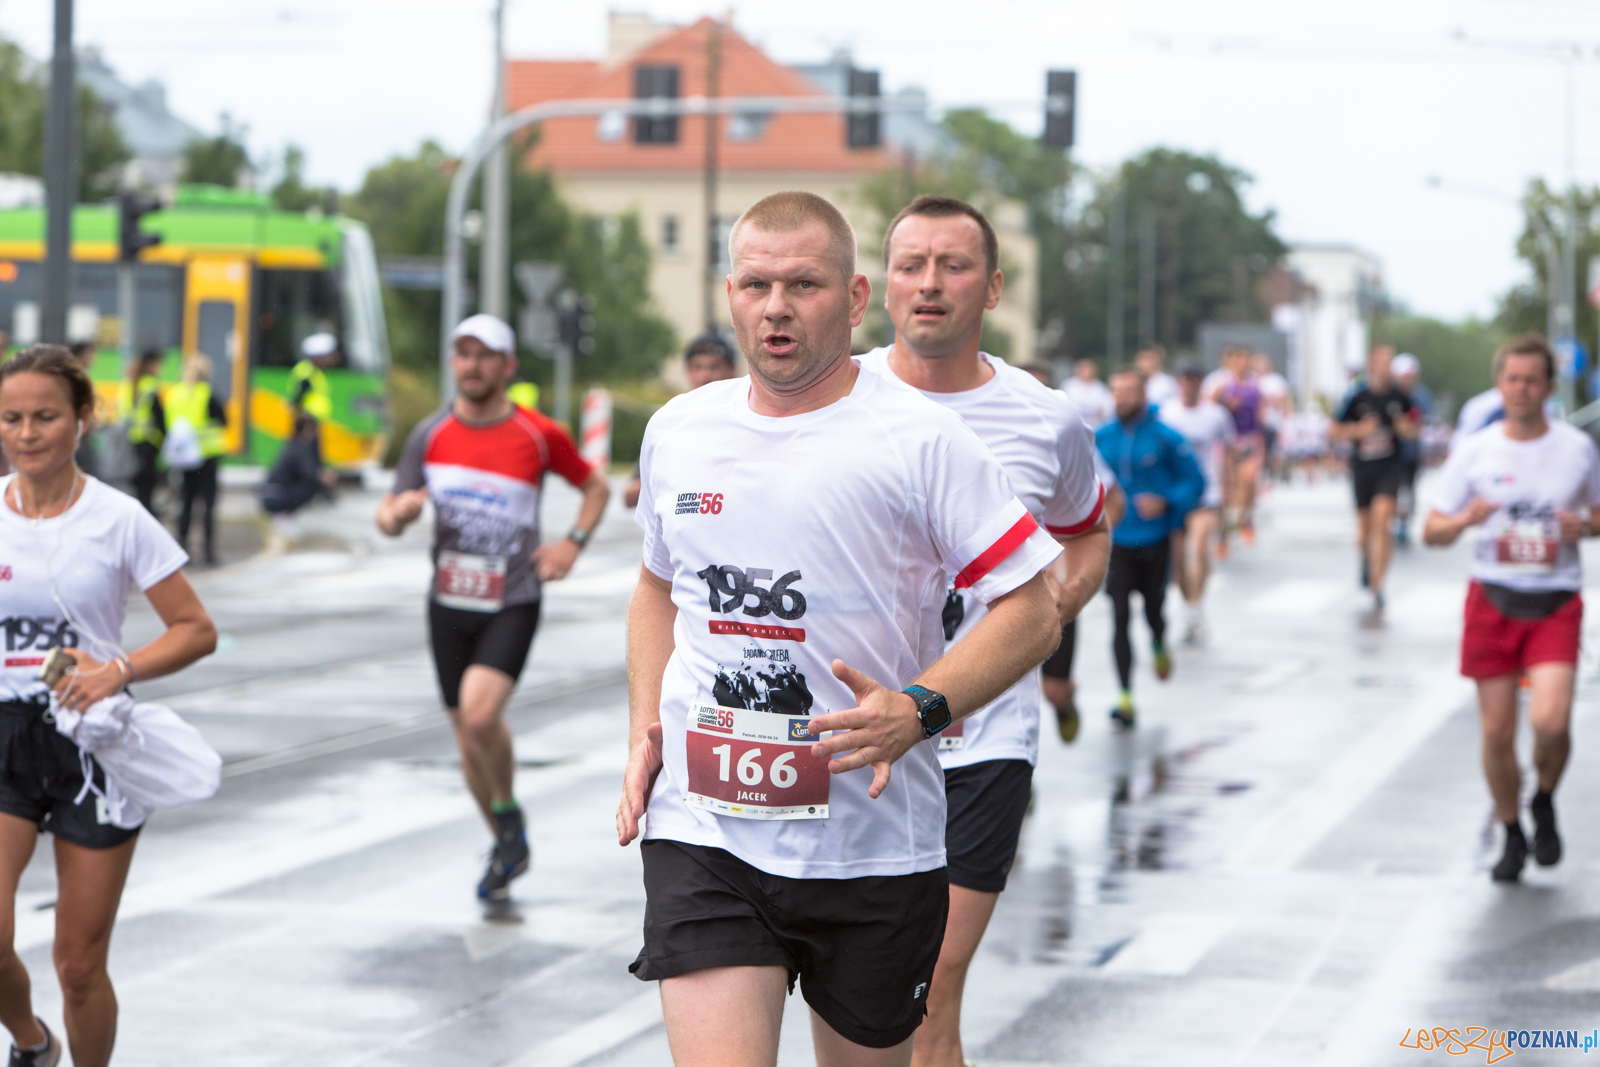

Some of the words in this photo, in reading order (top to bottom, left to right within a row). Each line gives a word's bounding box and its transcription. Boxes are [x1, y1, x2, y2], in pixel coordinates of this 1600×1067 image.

[677, 492, 698, 502] LOTTO
[696, 564, 807, 621] 1956
[700, 706, 716, 715] LOTTO
[712, 743, 798, 789] 166
[736, 790, 768, 802] JACEK
